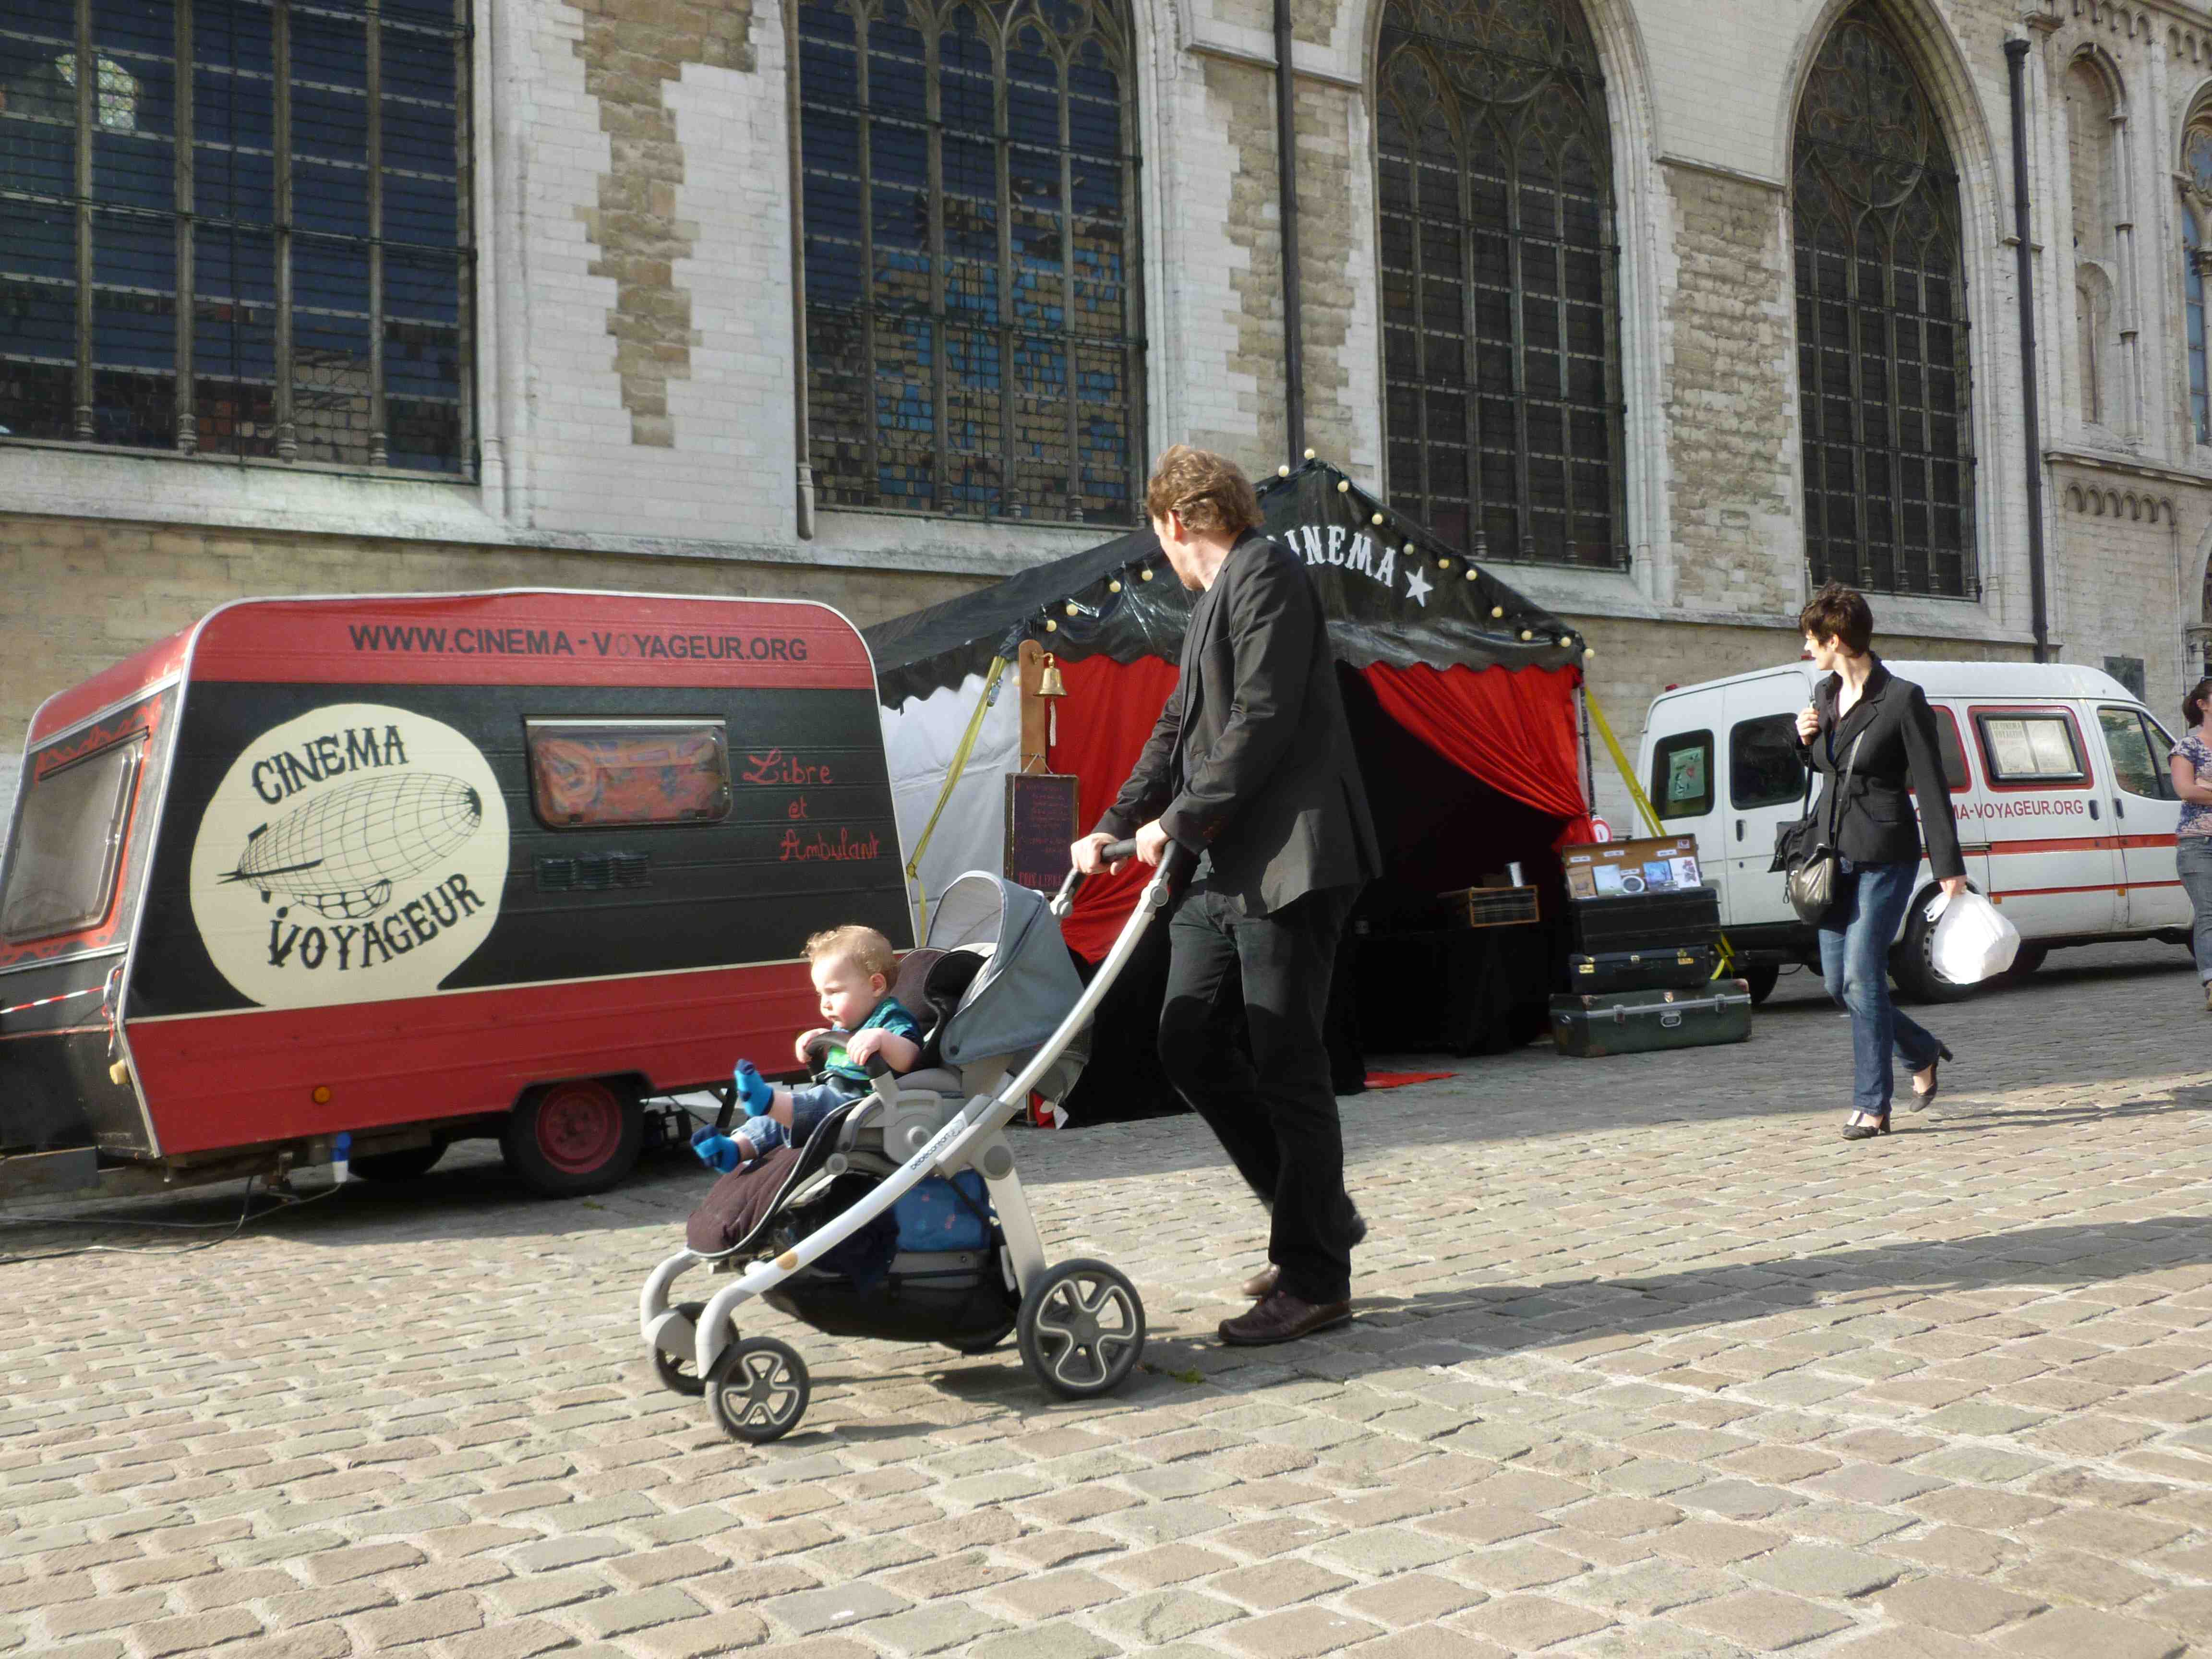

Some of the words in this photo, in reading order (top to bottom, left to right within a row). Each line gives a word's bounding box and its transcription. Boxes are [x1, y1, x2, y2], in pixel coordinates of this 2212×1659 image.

[1266, 525, 1395, 587] INEMA
[252, 725, 409, 805] CINEMA
[742, 746, 833, 784] Libre
[788, 795, 807, 819] et
[1914, 800, 2084, 822] MA-VOYAGEUR.ORG
[779, 825, 880, 861] Ambulant
[267, 873, 485, 971] VOYAGEUR
